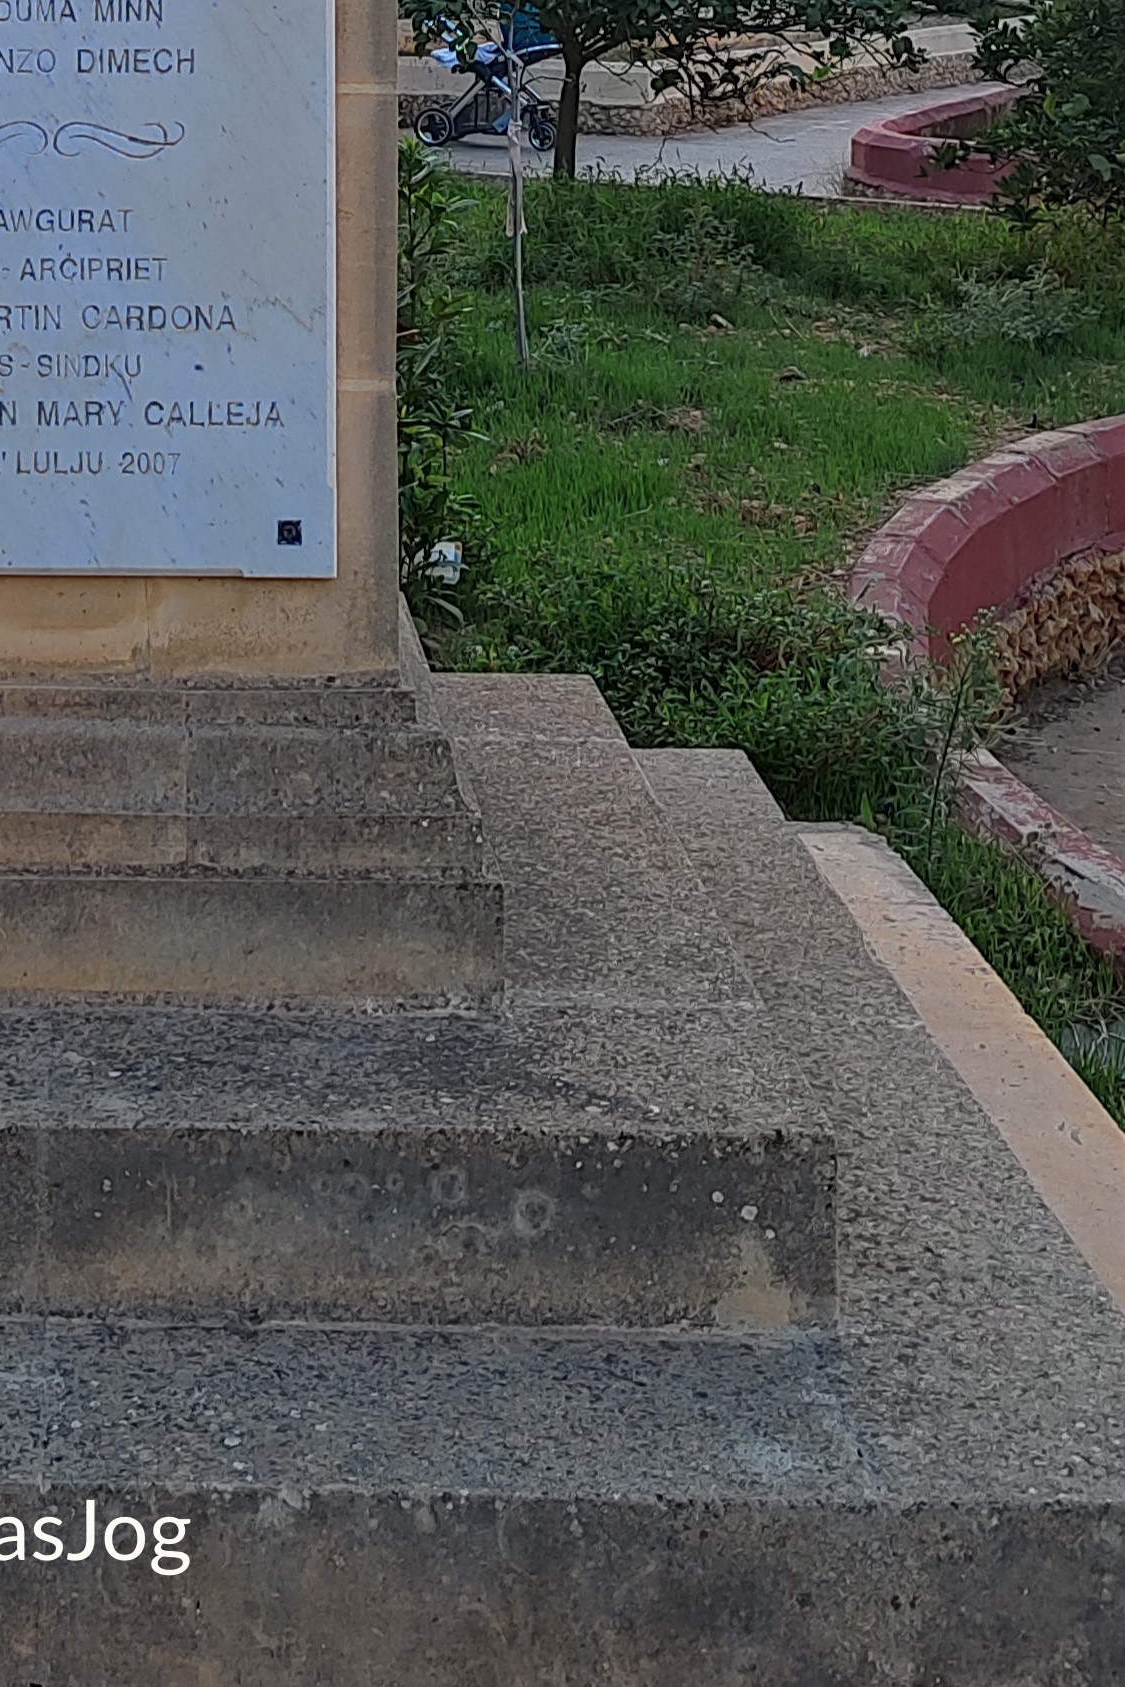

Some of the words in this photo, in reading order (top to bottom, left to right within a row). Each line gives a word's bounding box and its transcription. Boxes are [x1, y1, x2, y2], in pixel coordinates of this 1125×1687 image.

[76, 48, 196, 73] DIMECH
[82, 305, 237, 331] CARDONA
[37, 401, 124, 426] MARY
[144, 401, 284, 426] CALLEJA
[16, 451, 104, 475] LULJU
[121, 451, 182, 474] 2007
